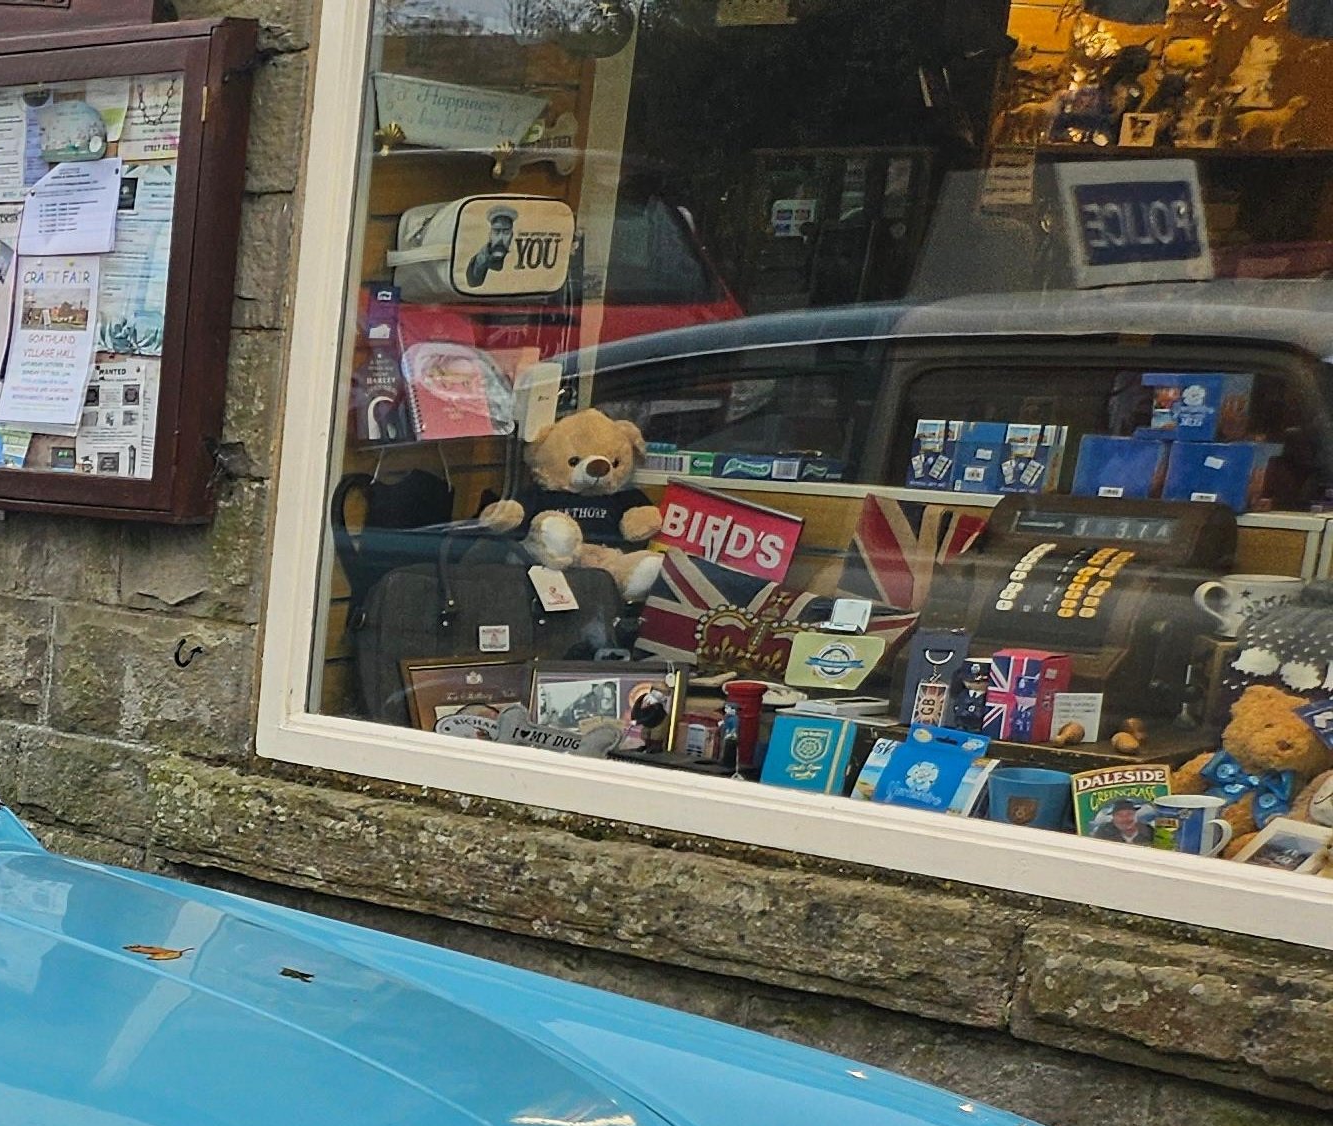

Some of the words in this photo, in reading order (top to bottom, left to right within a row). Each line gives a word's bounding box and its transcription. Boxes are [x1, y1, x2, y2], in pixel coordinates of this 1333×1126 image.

[514, 237, 564, 269] YOU
[23, 271, 58, 284] CRAFT
[62, 270, 90, 284] FAIR
[920, 698, 936, 716] GB
[532, 730, 552, 745] MY
[552, 735, 581, 751] DOG
[1077, 770, 1166, 790] DALESIDE
